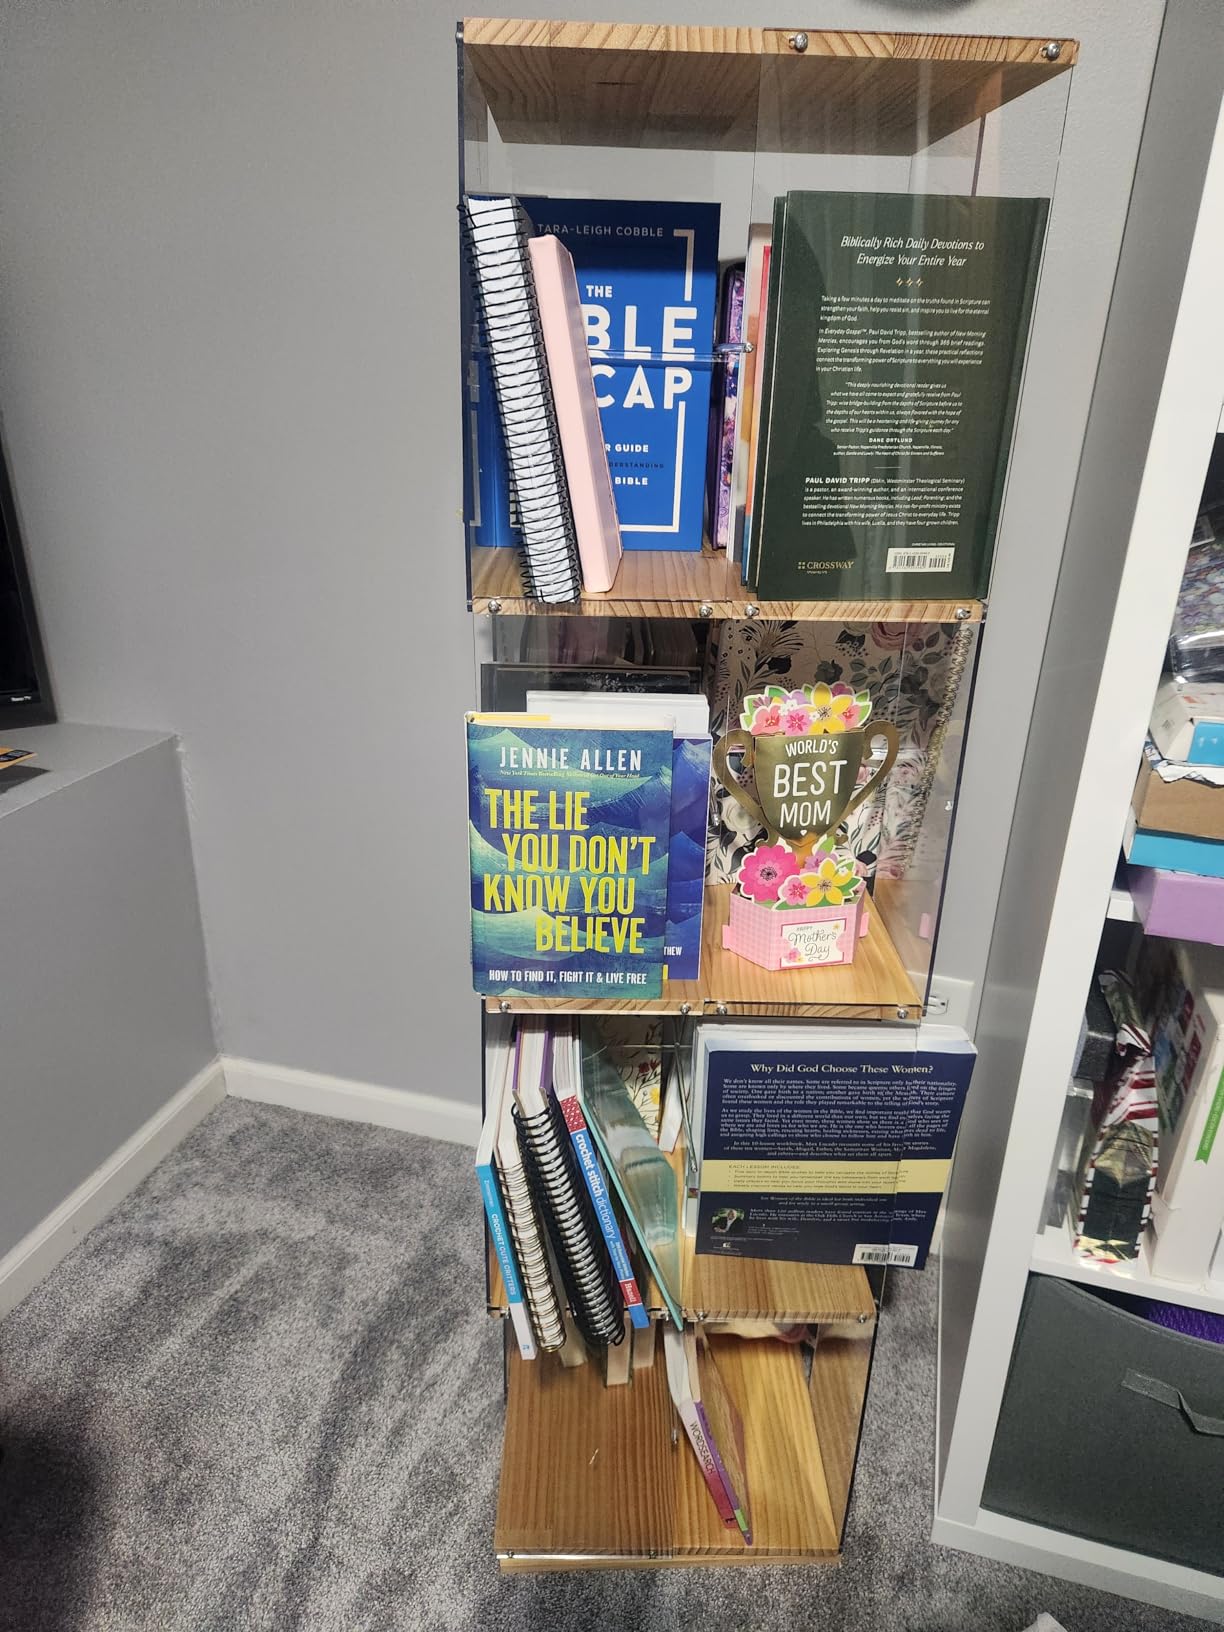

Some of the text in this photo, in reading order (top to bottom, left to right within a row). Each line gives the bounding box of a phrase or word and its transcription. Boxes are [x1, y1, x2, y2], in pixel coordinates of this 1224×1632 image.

[537, 224, 664, 237] TARA-LEIGH COBBLE
[840, 235, 985, 251] Biblically Rich Daily Devotions to
[856, 253, 967, 267] Energize Your Entire Year
[586, 285, 613, 298] THE
[580, 304, 698, 361] BLE
[880, 328, 894, 336] David
[817, 347, 840, 355] Exploring
[859, 347, 879, 355] through
[919, 338, 939, 347] through
[590, 364, 693, 410] CAP
[615, 443, 649, 453] GUIDE
[608, 461, 664, 469] DERSTANDING
[615, 477, 648, 485] BIBLE
[806, 561, 854, 569] CROSSWAY
[785, 739, 839, 757] WORLD'S
[499, 747, 641, 771] JENNIE ALLEN
[773, 760, 848, 798] BEST
[484, 788, 590, 831] THE LIE
[780, 800, 831, 828] MOM
[502, 833, 656, 875] YOU DON'T
[483, 873, 635, 916] KNOW YOU
[535, 915, 646, 954] BELIEVE
[788, 929, 836, 946] Mother's
[663, 946, 683, 956] THEW
[805, 943, 830, 962] Day
[489, 969, 647, 985] HOW TO FIND IT, FIGHT IT & LIVE FREE
[751, 1064, 934, 1074] Why Did God Choose These Women?
[867, 1079, 891, 1087] Scripture
[573, 1132, 595, 1170] crochet
[586, 1167, 605, 1197] stitch
[593, 1195, 617, 1240] dictionary
[490, 1213, 517, 1295] CROCHET CUTE CRITTERS
[689, 1421, 715, 1474] WORDSEARCH
